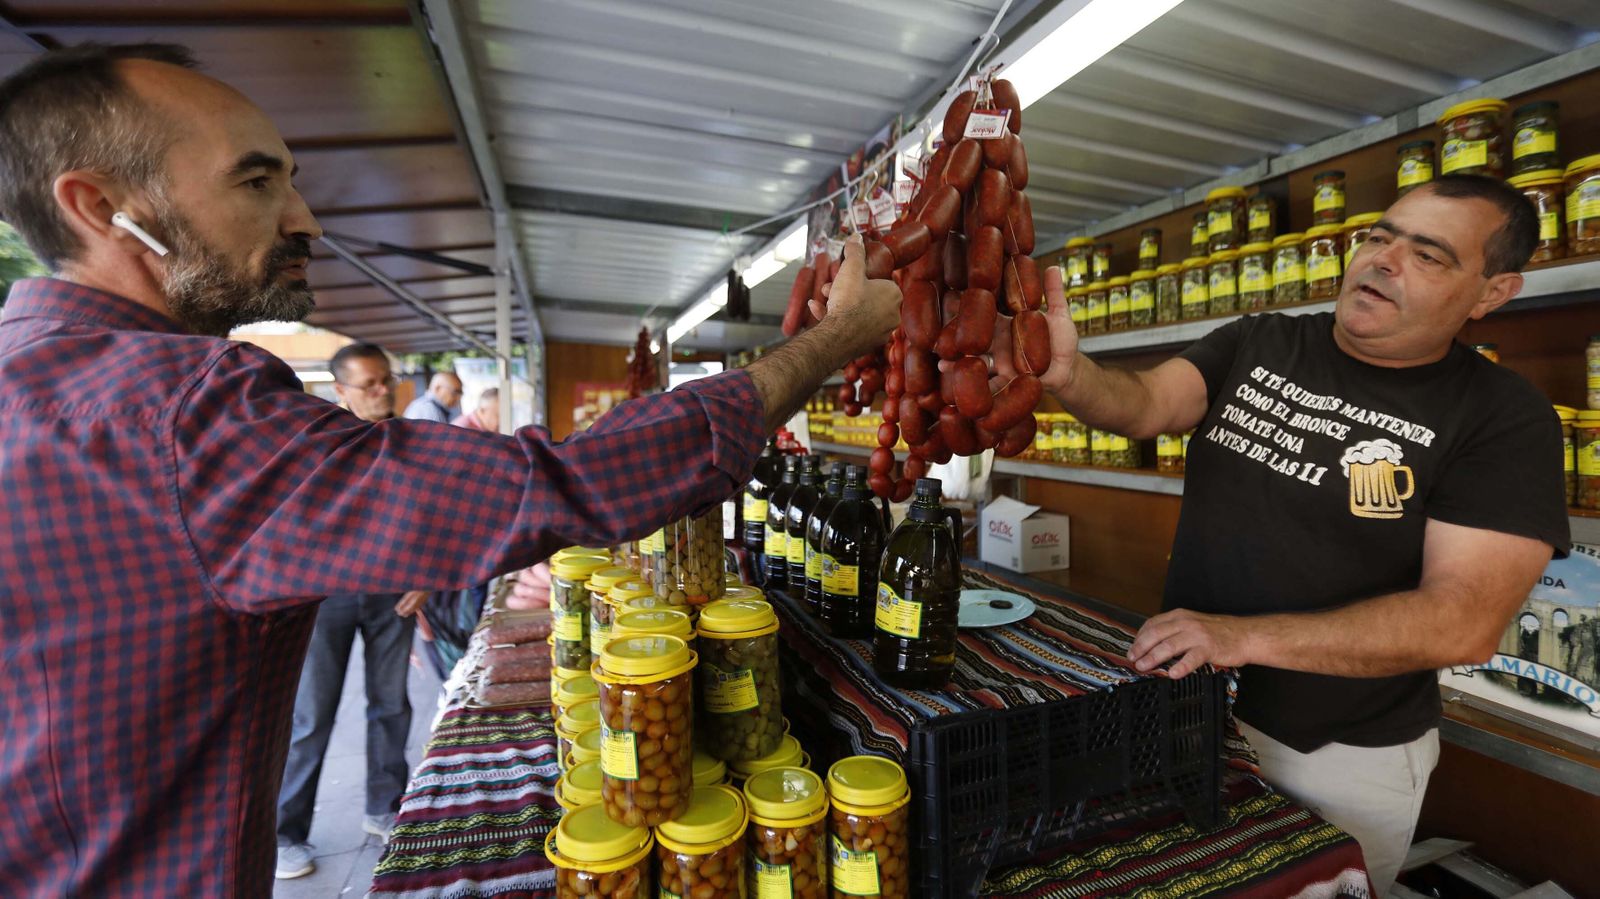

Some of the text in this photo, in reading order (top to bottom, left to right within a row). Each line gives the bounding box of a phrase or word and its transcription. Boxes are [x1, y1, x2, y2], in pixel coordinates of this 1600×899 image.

[1222, 404, 1305, 454] TOMATE UNA
[1236, 384, 1351, 441] COMO EL BRONCE
[1250, 366, 1436, 447] SI TE QUIERES MANTENER
[1206, 425, 1329, 486] ANTES DE LAS 11
